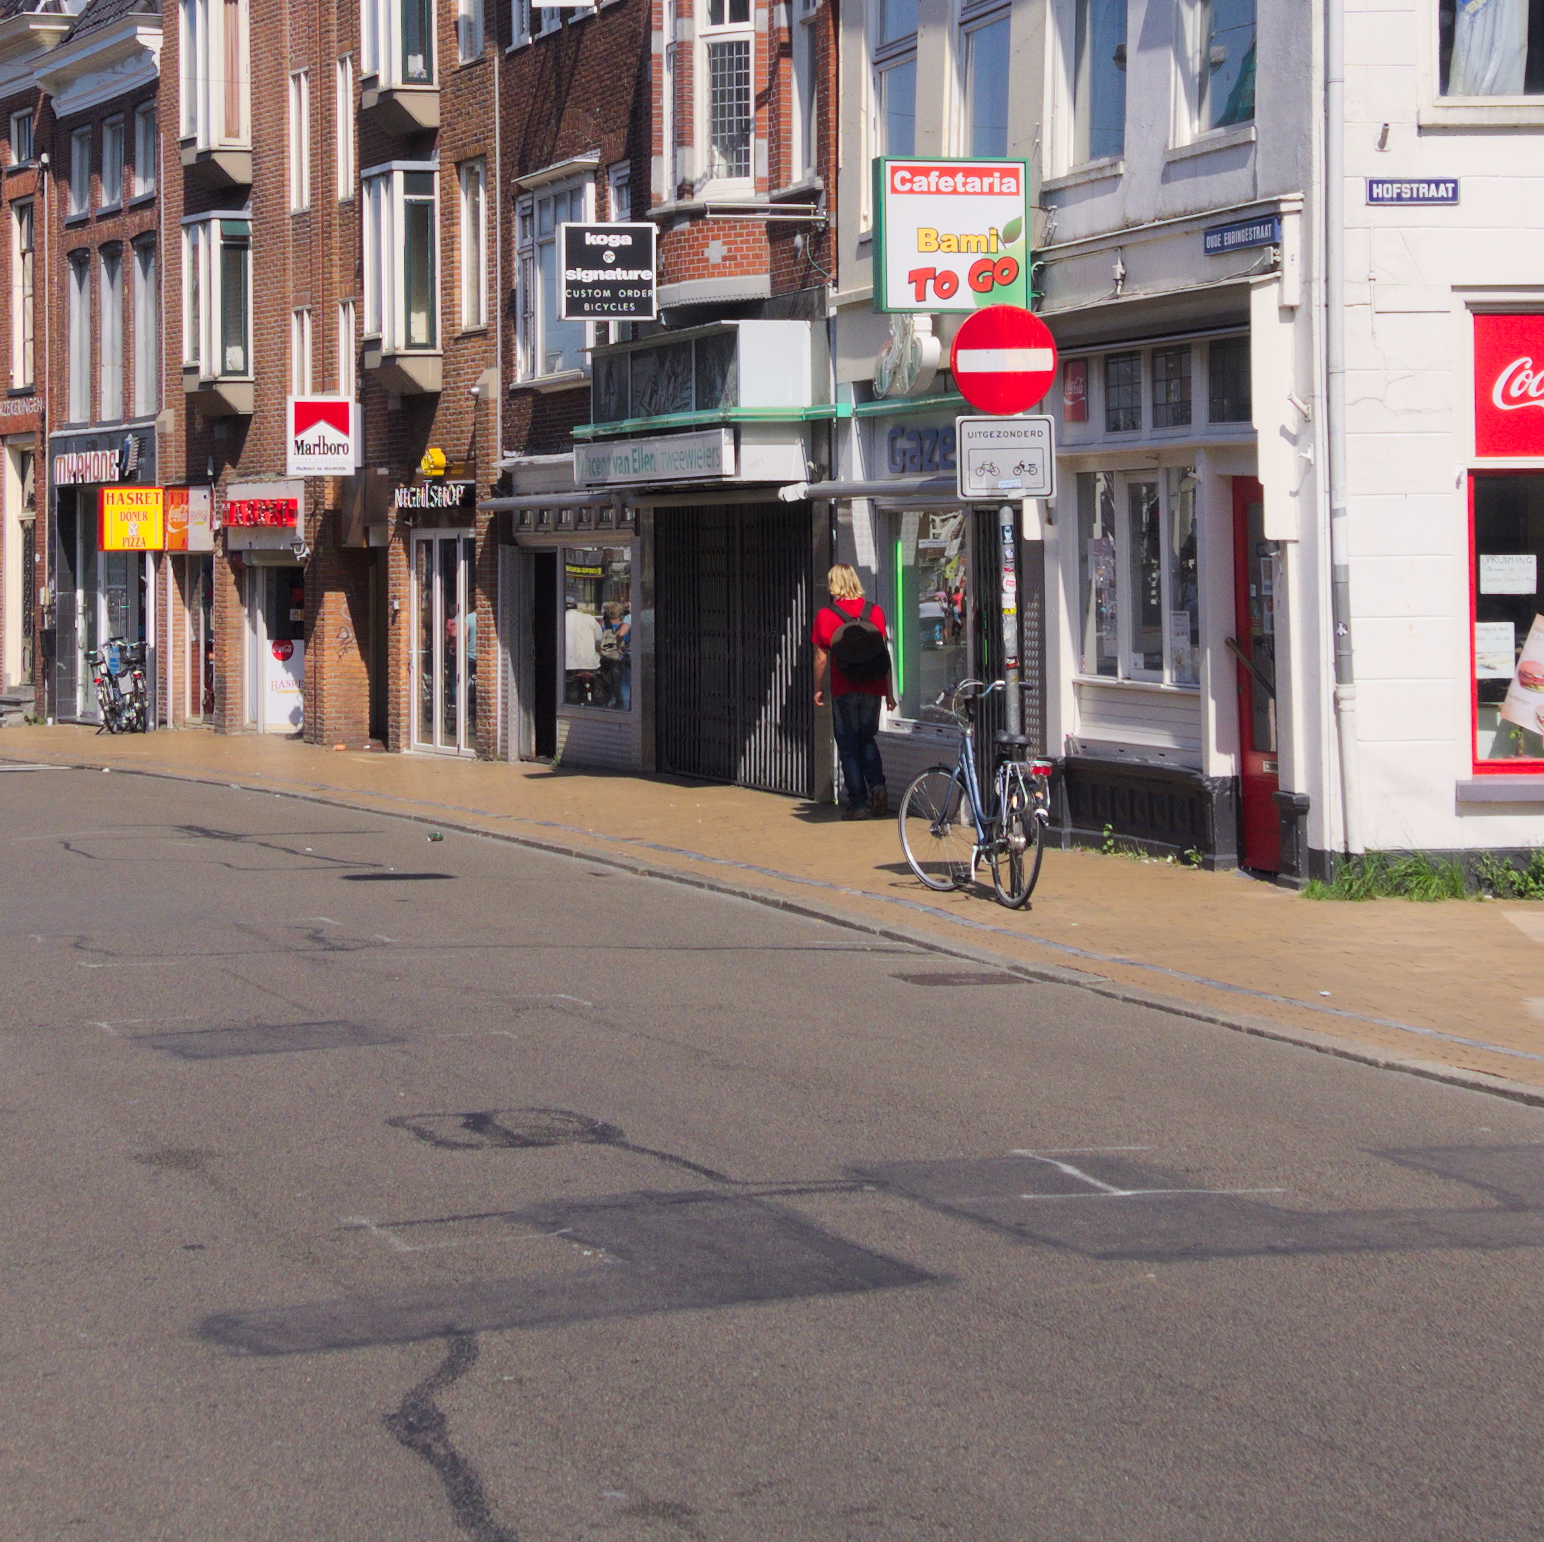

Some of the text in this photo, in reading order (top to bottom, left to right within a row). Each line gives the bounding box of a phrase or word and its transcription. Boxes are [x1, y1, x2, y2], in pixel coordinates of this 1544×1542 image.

[894, 170, 1017, 193] Cafetaria
[1372, 183, 1455, 198] HOFSTRAAT
[585, 232, 632, 247] koga
[917, 226, 999, 254] Bami
[1206, 223, 1272, 249] OUDE EBBINGESTRAAT
[565, 268, 653, 282] signature
[908, 256, 1019, 302] TO GO
[566, 289, 653, 298] CUSTOM ORDER
[583, 303, 636, 311] BICYCLES
[967, 430, 1044, 438] UITGEZONDERD
[293, 436, 349, 455] Marlboro
[613, 454, 630, 475] van
[631, 444, 656, 474] Ellen
[660, 441, 721, 472] tweewielers
[106, 492, 161, 505] HASRET
[128, 522, 139, 536] &
[122, 537, 146, 548] PIZZA
